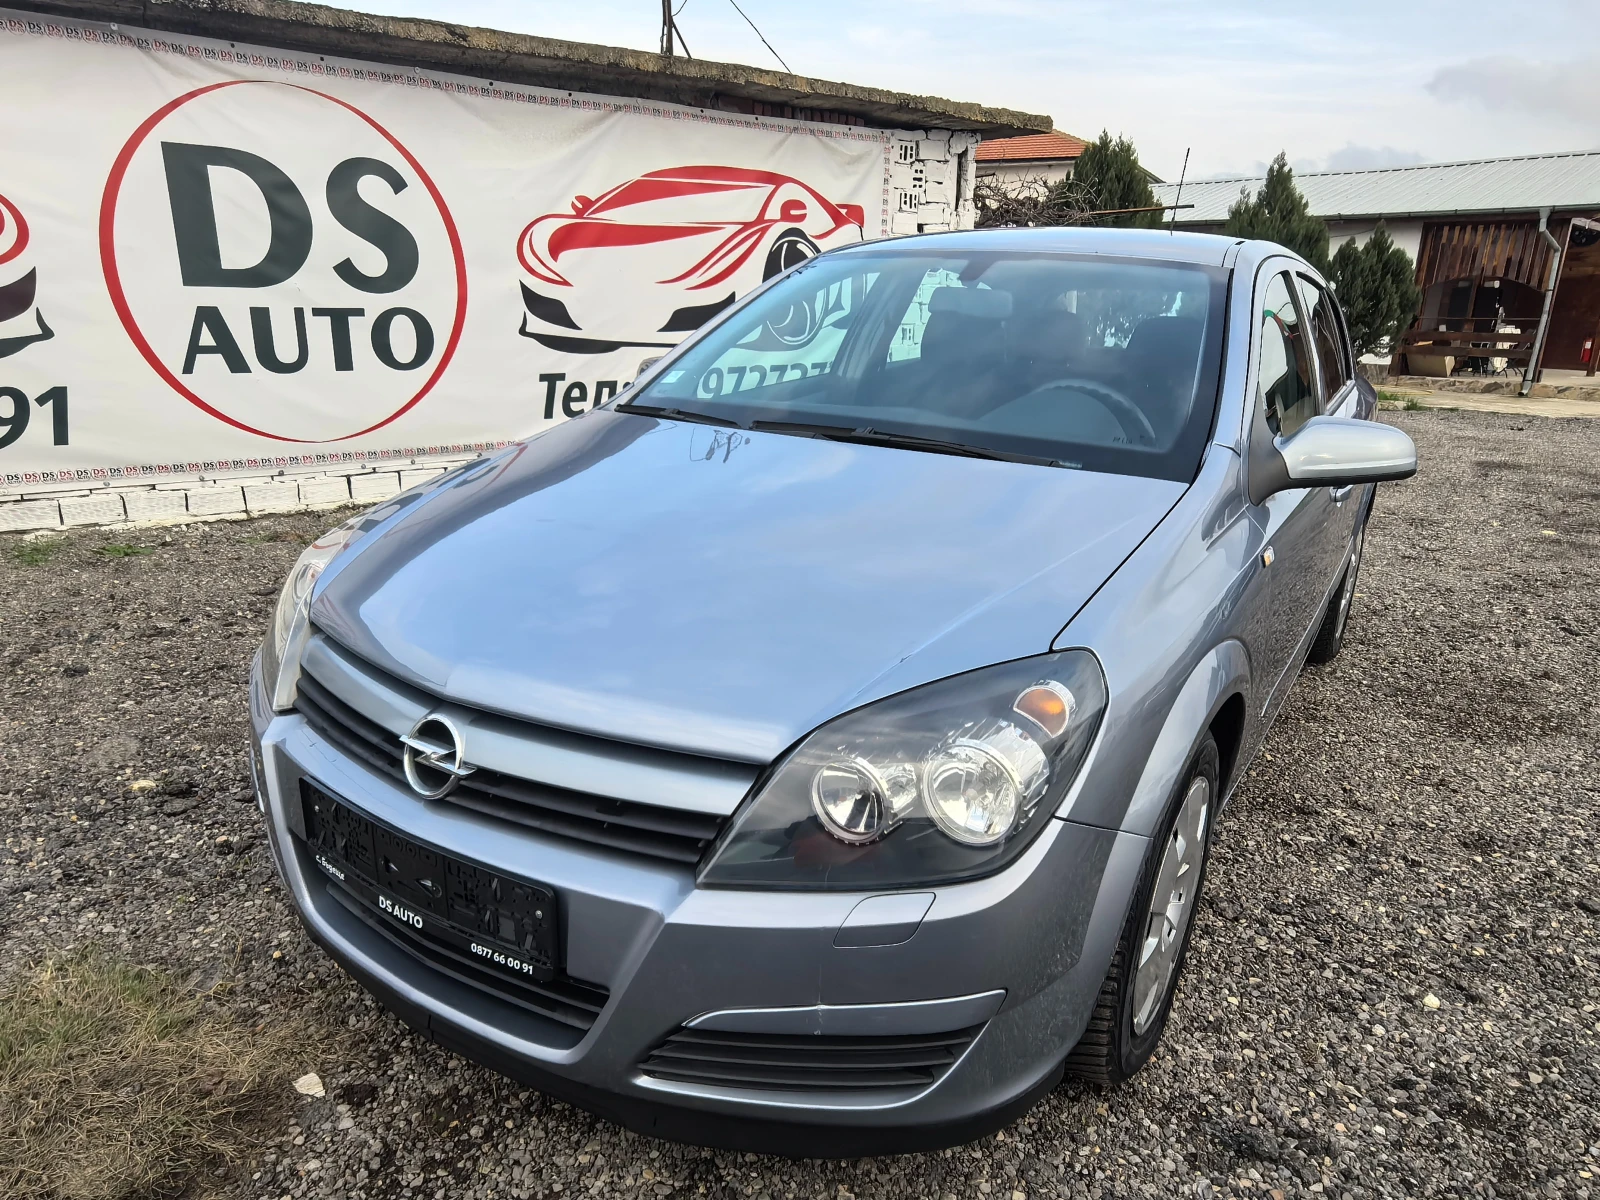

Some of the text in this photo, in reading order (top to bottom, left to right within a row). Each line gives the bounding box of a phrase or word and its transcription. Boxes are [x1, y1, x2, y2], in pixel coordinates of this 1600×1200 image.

[8, 19, 23, 28] DS
[27, 22, 42, 31] DS
[47, 24, 60, 34] DS
[66, 27, 79, 36] DS
[83, 30, 97, 39] DS
[102, 32, 114, 42] DS
[119, 35, 132, 44] DS
[137, 38, 149, 46] DS
[154, 40, 166, 49] DS
[171, 42, 183, 51] DS
[187, 45, 199, 53] DS
[204, 47, 216, 56] DS
[220, 49, 232, 58] DS
[236, 52, 247, 61] DS
[251, 55, 263, 63] DS
[161, 141, 419, 294] DS
[182, 306, 434, 375] AUTO
[6, 473, 19, 481] DS
[379, 896, 423, 929] DS AUTO
[470, 942, 534, 975] 0877 66 00 91
